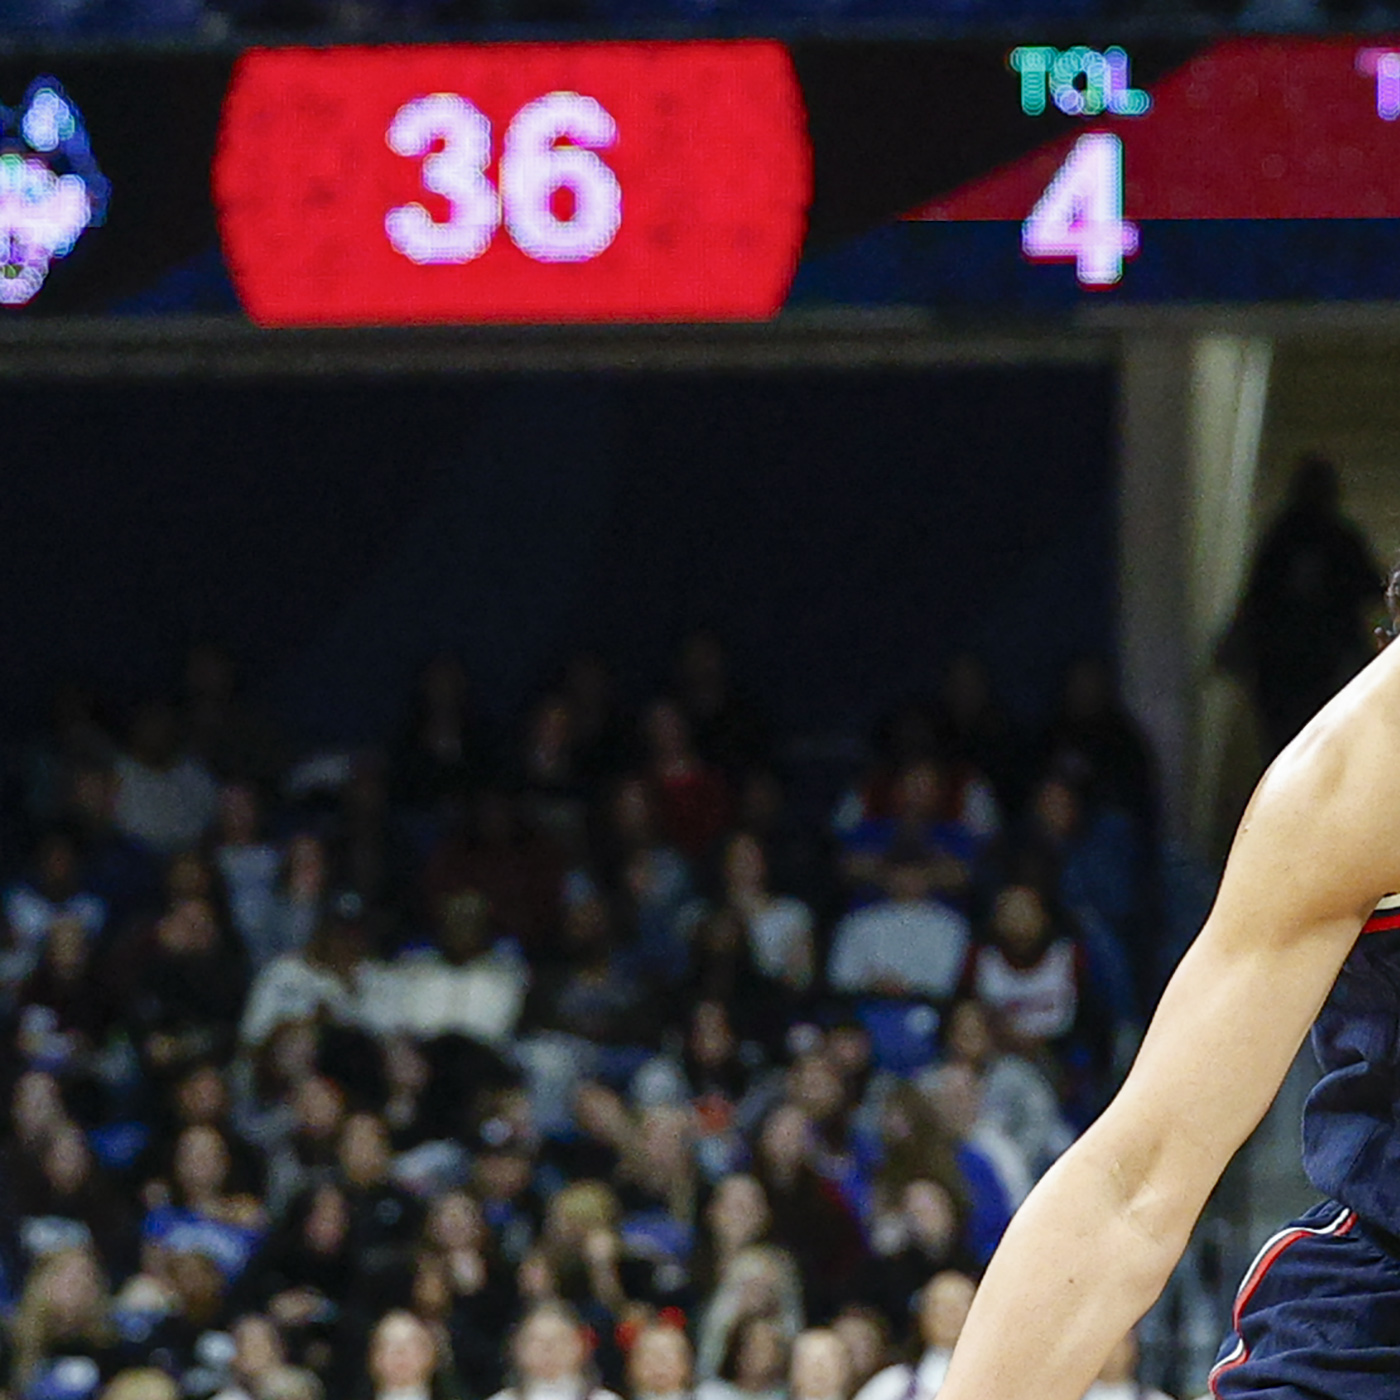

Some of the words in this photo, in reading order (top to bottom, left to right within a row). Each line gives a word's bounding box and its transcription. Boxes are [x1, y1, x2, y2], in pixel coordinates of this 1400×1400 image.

[1008, 45, 1153, 116] TOL
[384, 91, 622, 264] 36
[1021, 131, 1141, 290] 4
